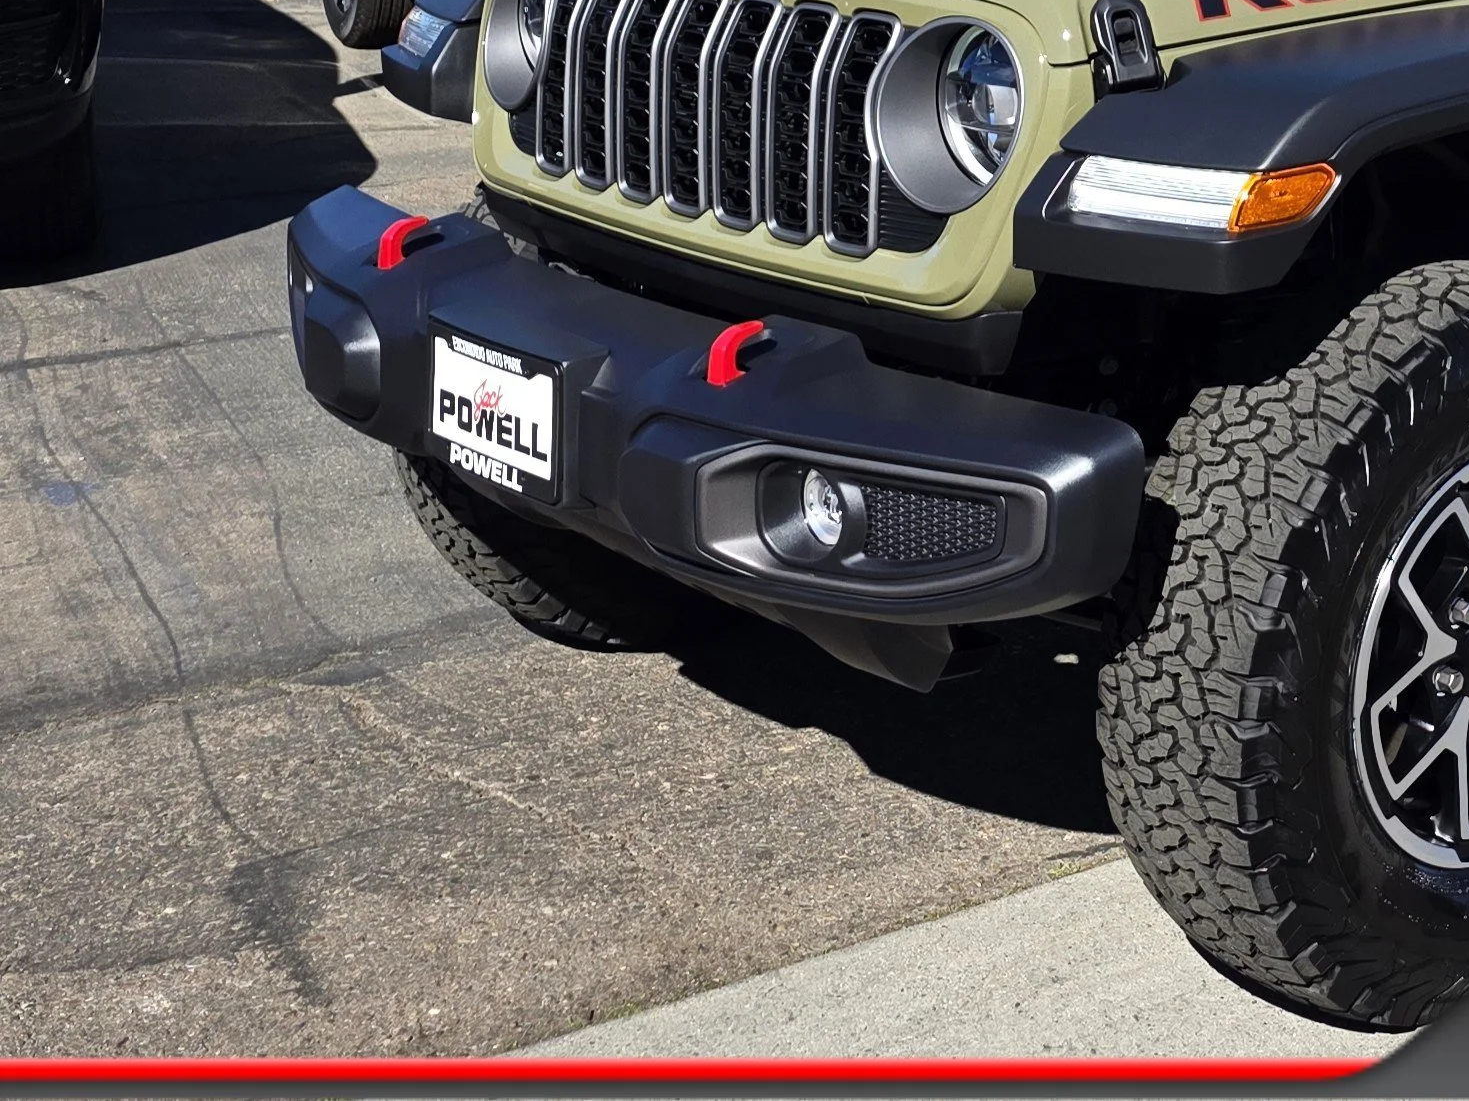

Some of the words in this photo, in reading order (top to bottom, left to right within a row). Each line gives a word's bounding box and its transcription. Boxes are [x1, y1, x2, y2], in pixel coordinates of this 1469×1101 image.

[486, 348, 504, 368] AUTO
[503, 354, 523, 375] PARK
[473, 378, 507, 421] Jack
[439, 388, 548, 462] POWELL
[450, 442, 523, 492] POWELL
